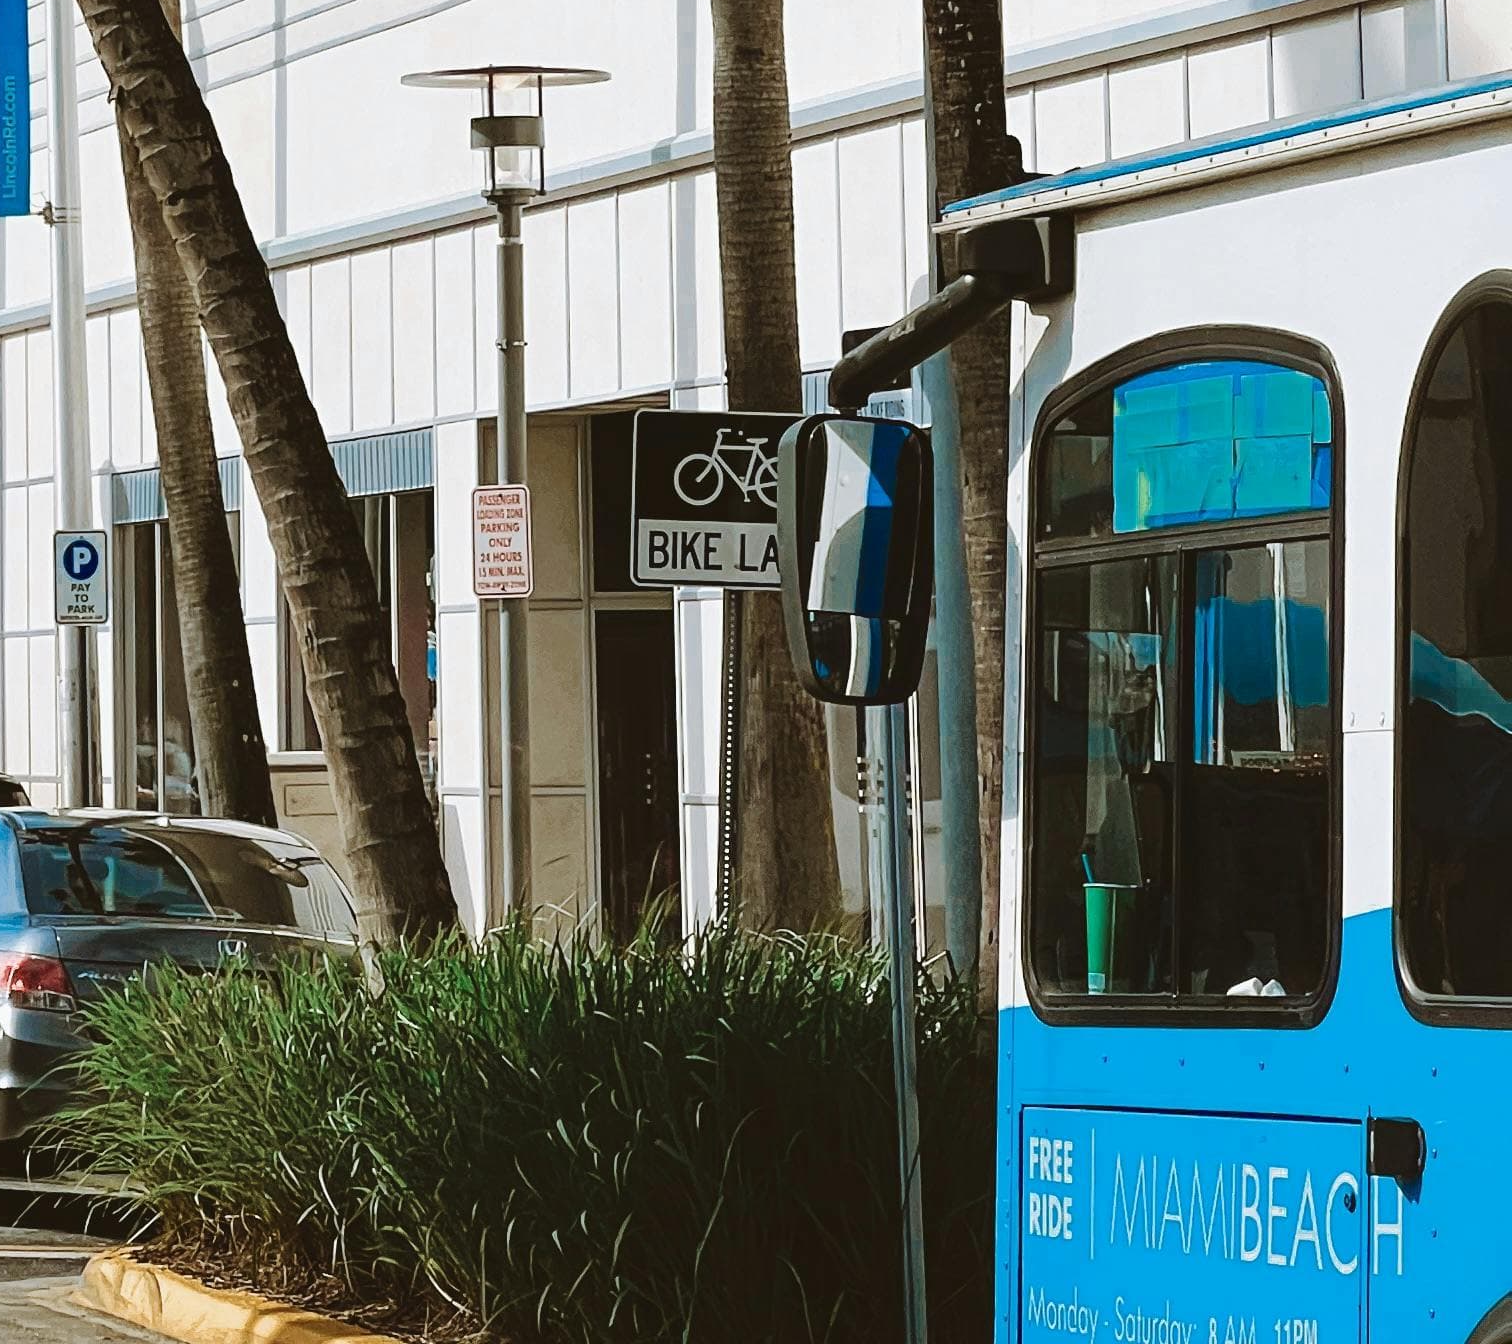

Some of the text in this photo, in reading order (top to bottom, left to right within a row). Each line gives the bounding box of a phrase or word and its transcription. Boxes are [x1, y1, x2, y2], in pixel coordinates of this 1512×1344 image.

[2, 75, 17, 200] LincolnRd.com
[478, 494, 521, 505] PASSENGER
[476, 509, 505, 519] LOADING
[480, 522, 520, 533] PARKING
[488, 537, 512, 548] ONLY
[648, 530, 723, 571] BIKE
[72, 546, 92, 574] P
[480, 551, 522, 563] 24 HOURS
[70, 583, 91, 592] PAY
[74, 594, 89, 603] TO
[67, 604, 95, 614] PARK
[1028, 1135, 1074, 1184] FREE
[1028, 1192, 1074, 1241] RIDE
[1028, 1286, 1099, 1344] Monday
